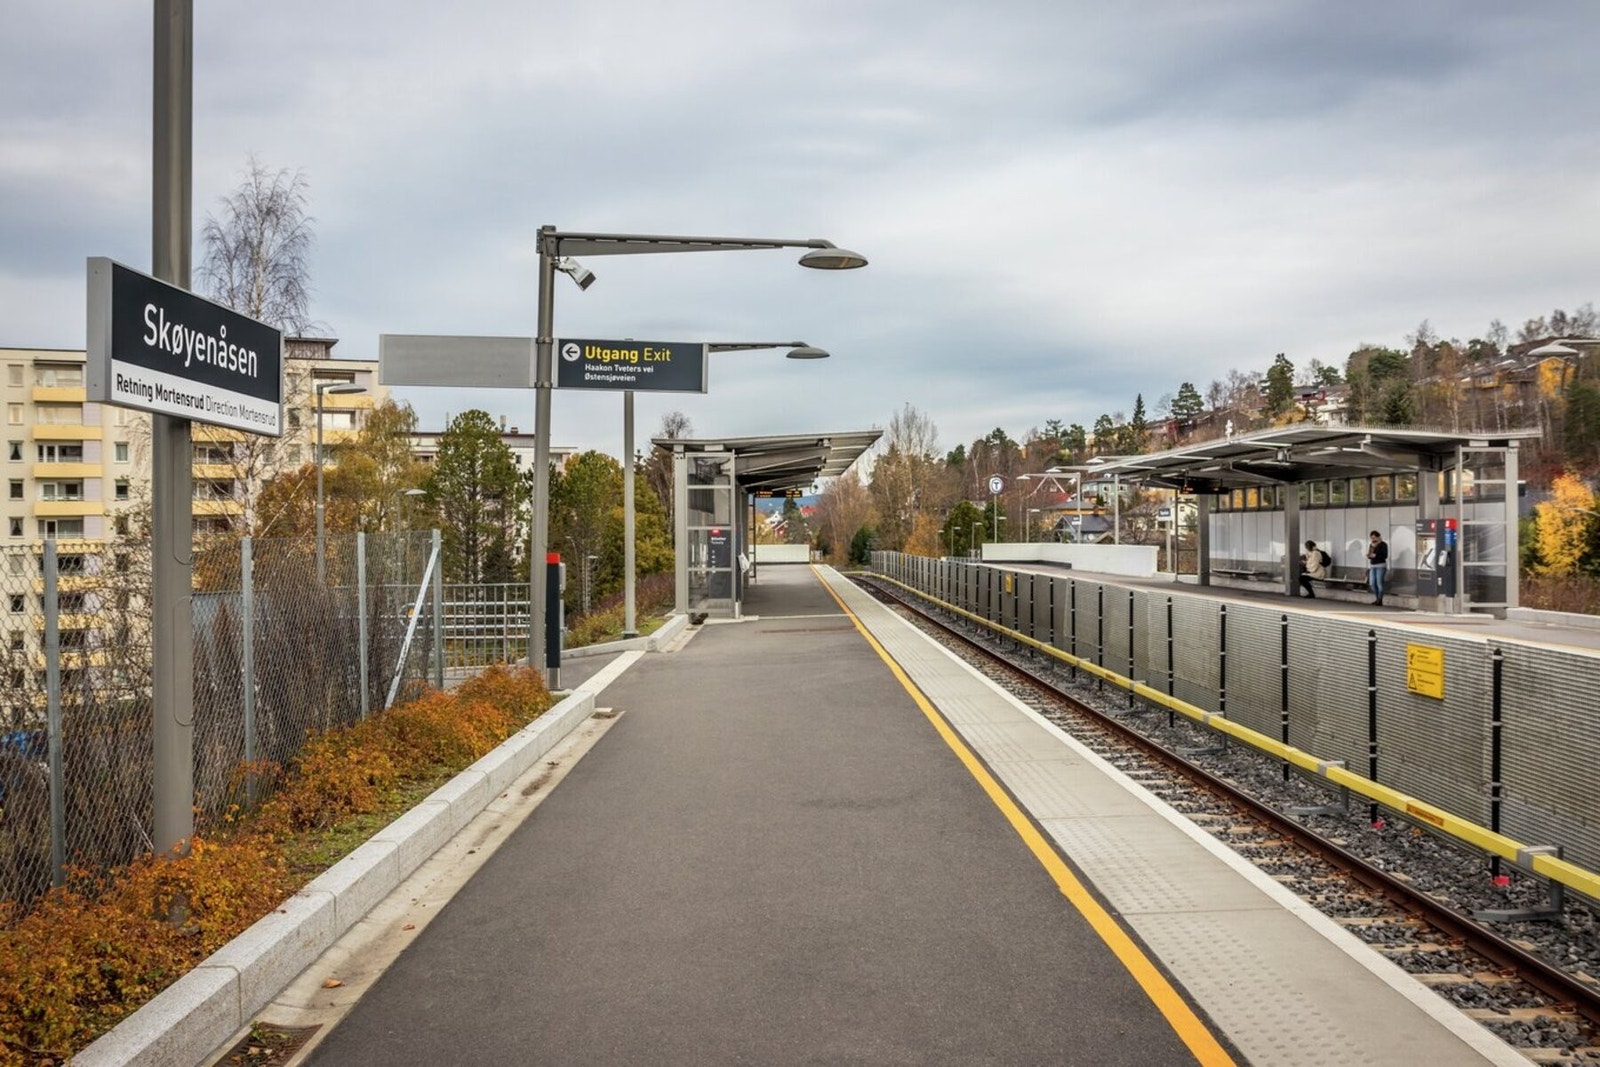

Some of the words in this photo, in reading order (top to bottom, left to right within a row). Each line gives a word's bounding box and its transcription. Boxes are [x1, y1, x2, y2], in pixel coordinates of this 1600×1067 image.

[143, 303, 258, 378] Skøyenåsen
[585, 346, 639, 363] Utgang
[644, 347, 671, 362] Exit
[585, 364, 613, 372] Haakon
[614, 364, 642, 373] Tveters
[642, 365, 654, 373] vei
[585, 373, 636, 382] Østensjøveien
[117, 373, 154, 403] Retning
[155, 384, 205, 410] Mortensrud
[206, 395, 238, 418] Direction
[239, 404, 276, 427] Mortensrud
